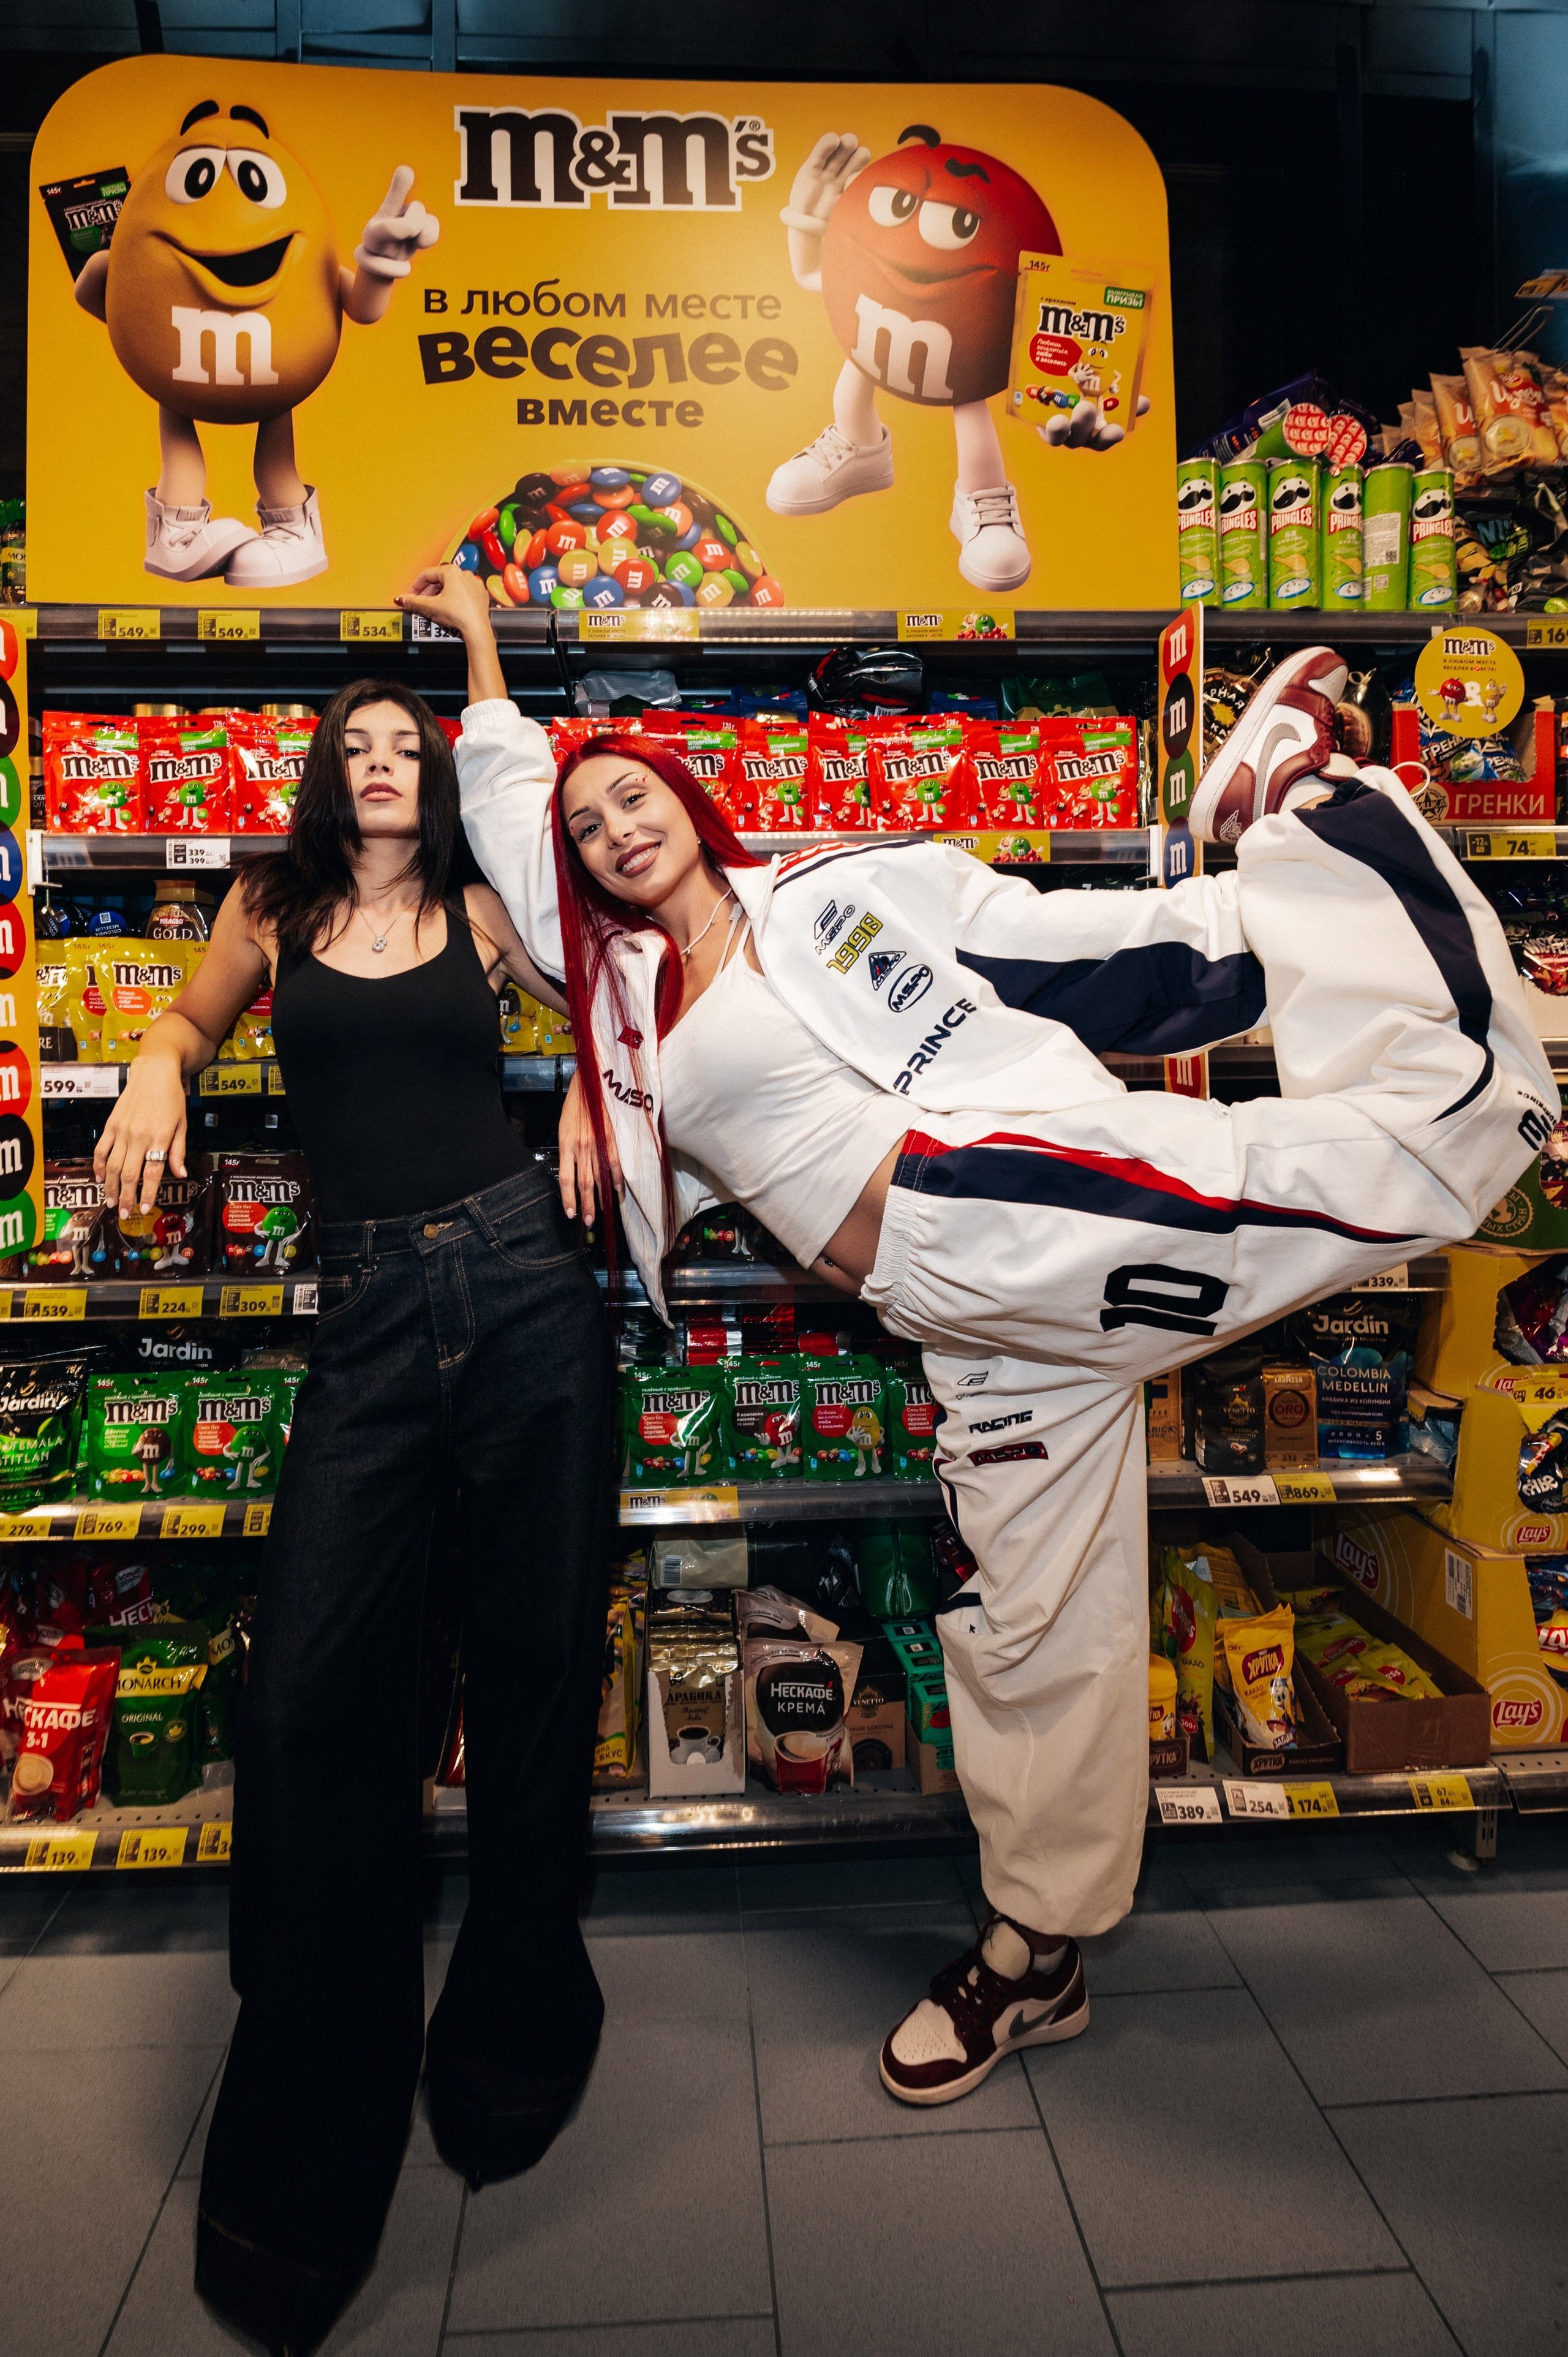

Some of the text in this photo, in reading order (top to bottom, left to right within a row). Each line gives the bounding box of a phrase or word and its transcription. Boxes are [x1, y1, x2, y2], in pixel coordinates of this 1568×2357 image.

[1030, 260, 1051, 271] 145г
[461, 279, 626, 318] любом
[645, 293, 781, 320] месте
[1106, 295, 1144, 307] ПРИЗЫ
[172, 306, 279, 385] m
[851, 293, 954, 399] m
[417, 325, 799, 391] веселее
[517, 398, 704, 428] вместе
[1221, 510, 1257, 535] RINGLES
[1271, 507, 1313, 536] PRINGLES
[1413, 518, 1453, 541] PRINGLES
[118, 627, 145, 638] 549
[218, 628, 244, 638] 549
[363, 626, 387, 638] 534
[1547, 628, 1568, 643] 16
[682, 754, 725, 777] &m's
[1455, 794, 1545, 815] ГРЕНКИ
[1507, 840, 1529, 856] 74
[153, 928, 194, 940] GOLD
[112, 962, 182, 988] m&m's
[891, 966, 930, 1011] MSPO
[892, 998, 978, 1096] PRINCE
[43, 1080, 75, 1093] 599
[221, 1079, 246, 1091] 549
[228, 1180, 301, 1203] m&m's
[1371, 1277, 1393, 1287] 339
[41, 1305, 68, 1318] 539
[161, 1302, 186, 1314] 224
[240, 1301, 267, 1313] 309
[1313, 1314, 1389, 1335] Jardin
[138, 1338, 213, 1360] Jardin
[1317, 1366, 1391, 1379] COLOMBIA
[815, 1379, 881, 1406] m&m's
[1322, 1380, 1389, 1393] MEDELLIN
[1534, 1387, 1556, 1400] 46
[0, 1393, 57, 1413] Jardin
[1275, 1405, 1303, 1414] ORO
[104, 1398, 178, 1426] m&m's
[197, 1397, 271, 1424] m&m's
[968, 1409, 1033, 1435] RACING
[1376, 1430, 1382, 1441] 5
[1232, 1490, 1261, 1503] 549
[1293, 1487, 1319, 1499] 869
[9, 1525, 34, 1536] 279
[97, 1522, 123, 1533] 769
[180, 1525, 207, 1536] 299
[1519, 1526, 1549, 1544] Lay's
[1335, 1533, 1378, 1582] Lay's
[1181, 1656, 1204, 1669] КАКАО
[1248, 1651, 1280, 1680] ХРУТКА
[667, 1691, 722, 1702] АРАБИКА
[853, 1697, 884, 1706] VENETTO
[122, 1712, 164, 1723] ORIGINAL
[1497, 1700, 1540, 1727] Lay's
[600, 1749, 623, 1762] ВКУС
[1253, 1754, 1284, 1770] ХРУТКА
[1436, 1787, 1447, 1797] 67
[1177, 1806, 1205, 1820] 389
[1250, 1800, 1273, 1814] 254
[1298, 1799, 1322, 1813] 174
